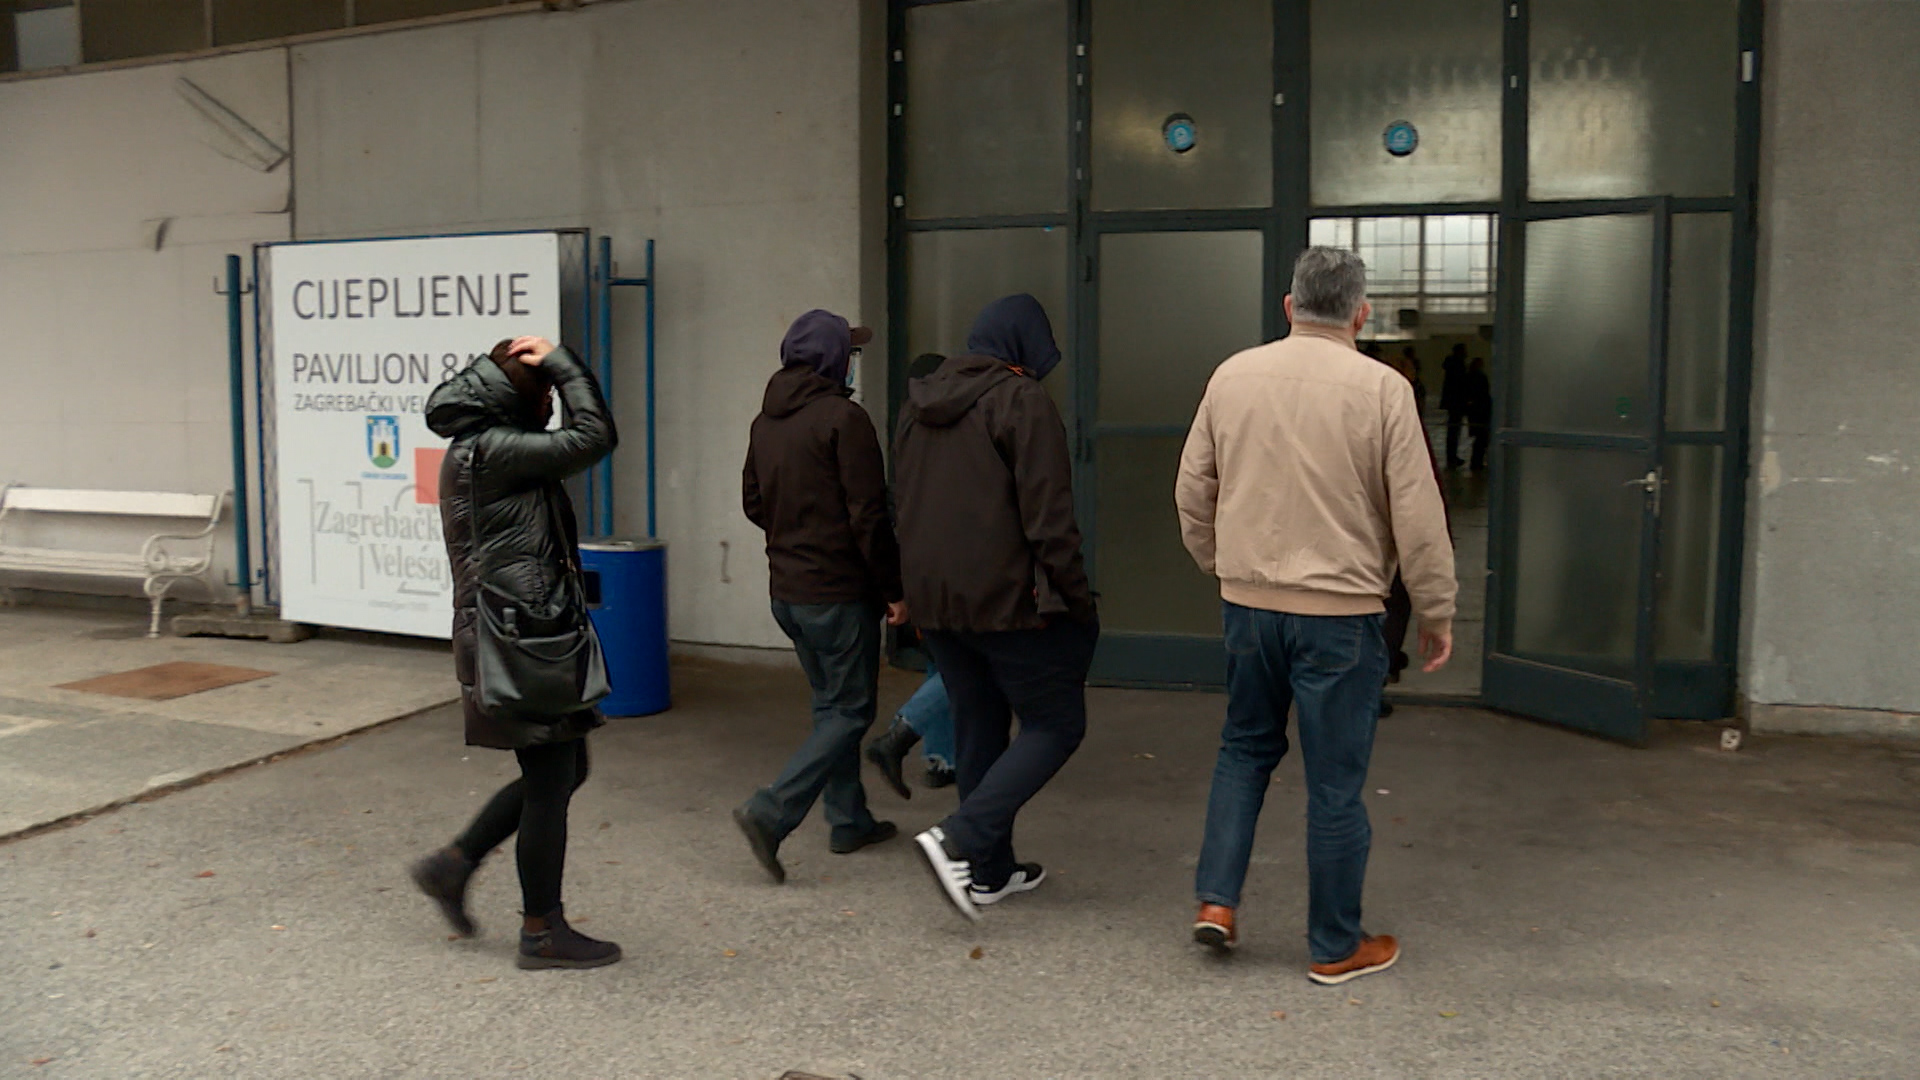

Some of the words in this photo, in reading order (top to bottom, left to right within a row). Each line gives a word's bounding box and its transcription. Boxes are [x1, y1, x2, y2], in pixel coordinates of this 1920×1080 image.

[292, 273, 531, 320] CIJEPLJENJE
[293, 352, 429, 384] PAVILJON
[294, 391, 393, 412] ZAGREBAČKI
